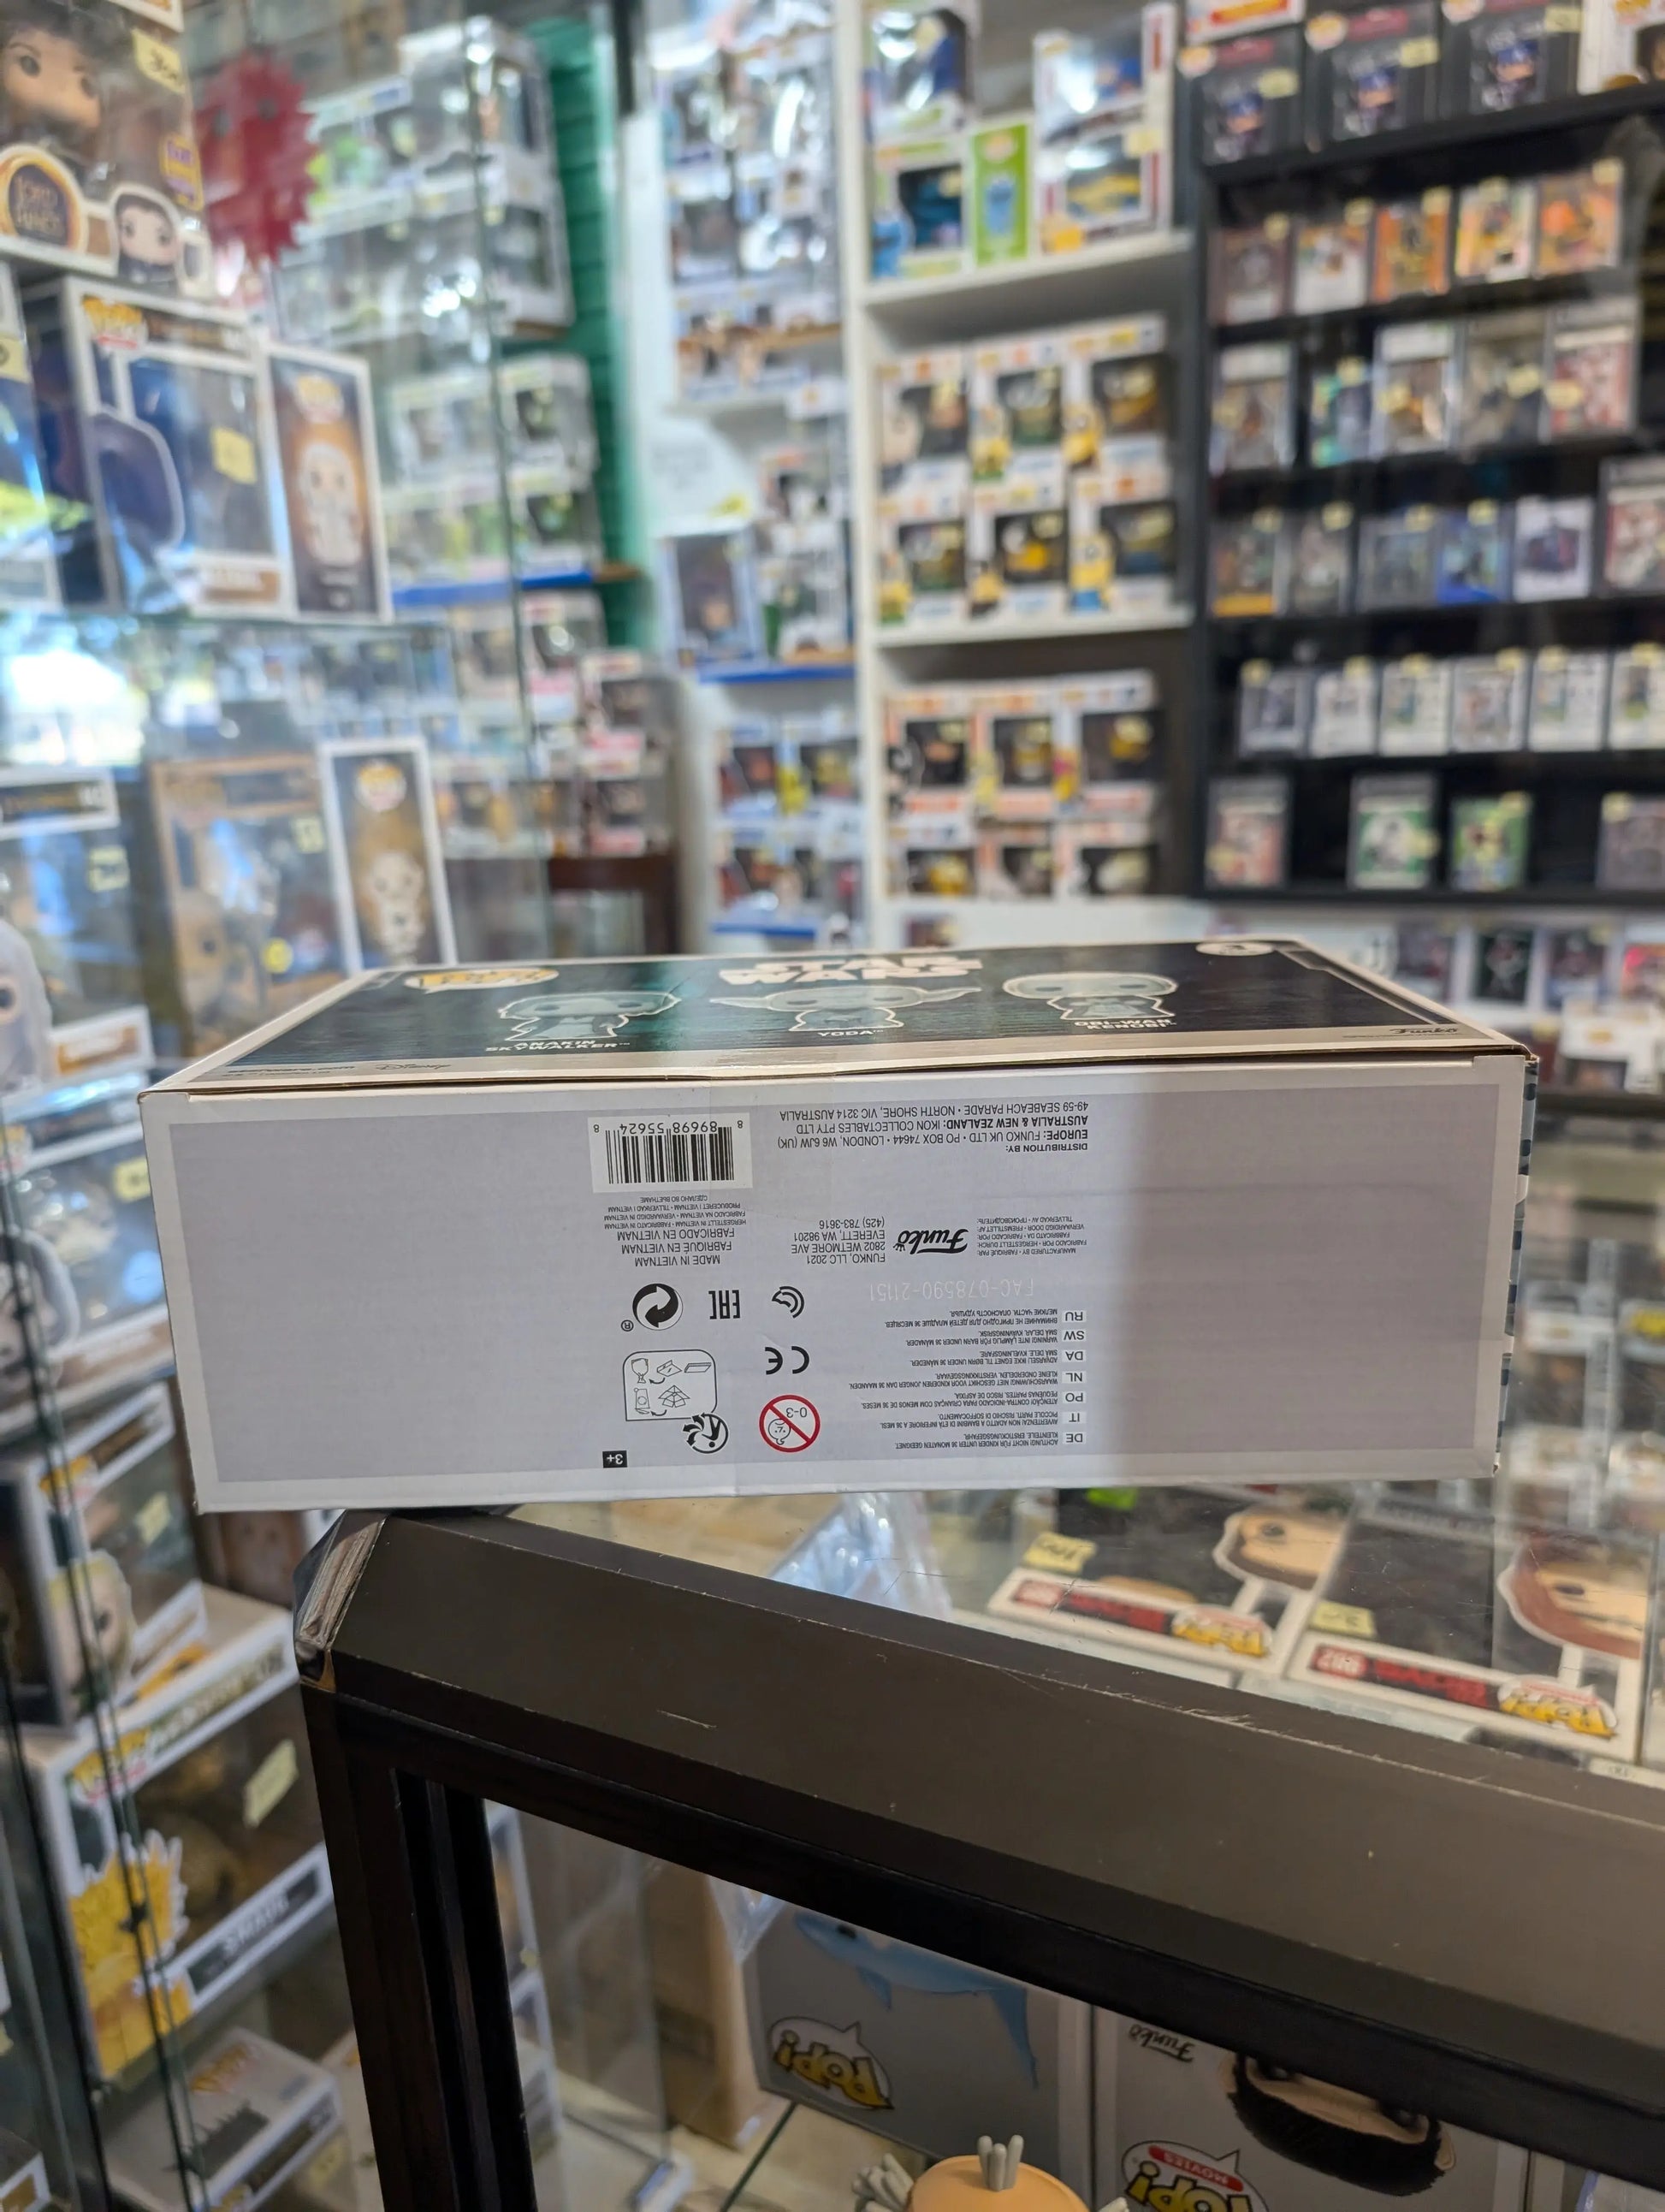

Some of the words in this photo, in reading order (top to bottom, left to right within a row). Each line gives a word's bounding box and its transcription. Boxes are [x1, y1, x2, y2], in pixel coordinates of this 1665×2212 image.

[1074, 1018, 1172, 1027] OBI-WAN
[880, 1106, 918, 1118] SHORE,
[921, 1106, 956, 1117] NORTH
[964, 1105, 1004, 1116] PARADE
[1006, 1103, 1060, 1114] SEABEACH
[1063, 1102, 1088, 1112] 49-59
[780, 1110, 834, 1122] AUSTRALIA
[837, 1109, 859, 1119] 3214
[862, 1108, 878, 1118] VIC
[737, 1120, 743, 1129] 8
[916, 1120, 940, 1131] IKON
[942, 1118, 993, 1130] ZEALAND:
[996, 1118, 1019, 1129] NEW
[1022, 1118, 1028, 1128] &
[1032, 1116, 1088, 1127] AUSTRALIA
[593, 1124, 599, 1133] 8
[619, 1123, 664, 1135] 55624
[672, 1121, 717, 1134] 89698
[797, 1124, 815, 1135] LTD
[817, 1124, 836, 1134] PTY
[838, 1121, 914, 1134] COLLECTABLES
[841, 1135, 885, 1147] LONDON,
[893, 1135, 920, 1145] 74644
[923, 1134, 944, 1144] BOX
[946, 1134, 960, 1144] PO
[969, 1133, 987, 1143] LTD
[990, 1132, 1004, 1142] UK
[1006, 1131, 1040, 1142] FUNKO
[1042, 1130, 1088, 1141] EUROPE:
[778, 1137, 797, 1149] (UK)
[801, 1138, 821, 1148] 6JW
[822, 1137, 838, 1148] W6
[1023, 1143, 1088, 1153] DISTRIBUTION
[819, 1219, 860, 1230] 783-3616
[862, 1217, 885, 1228] (425)
[617, 1231, 661, 1242] VIETNAM
[663, 1230, 677, 1240] EN
[679, 1228, 735, 1239] FABRICADO
[794, 1232, 820, 1242] 98201
[821, 1231, 837, 1242] WA
[838, 1230, 886, 1241] EVERETT,
[864, 1242, 886, 1252] 2802
[896, 1229, 969, 1254] Funko
[622, 1243, 665, 1254] VIETNAM
[667, 1243, 681, 1253] EN
[684, 1242, 732, 1254] FABRIQUÉ
[791, 1244, 809, 1254] AVE
[812, 1242, 862, 1254] WETMORE
[635, 1256, 678, 1267] VIETNAM
[680, 1256, 690, 1266] IN
[693, 1255, 720, 1266] MADE
[807, 1255, 827, 1265] 2021
[830, 1254, 847, 1264] LLC
[849, 1253, 886, 1264] FUNKO,
[708, 1290, 741, 1319] EAC
[1064, 1311, 1083, 1321] RU
[1064, 1330, 1084, 1340] SW
[765, 1346, 809, 1374] CE
[1065, 1350, 1083, 1361] DA
[1066, 1373, 1082, 1382] NL
[1065, 1392, 1083, 1402] PO
[785, 1407, 808, 1418] 0-3
[1068, 1413, 1080, 1422] IT
[1066, 1432, 1083, 1443] DE
[606, 1454, 623, 1465] 3+
[1129, 2024, 1195, 2064] Funko
[773, 2030, 892, 2110] POP!
[1164, 2152, 1229, 2185] MOVIES
